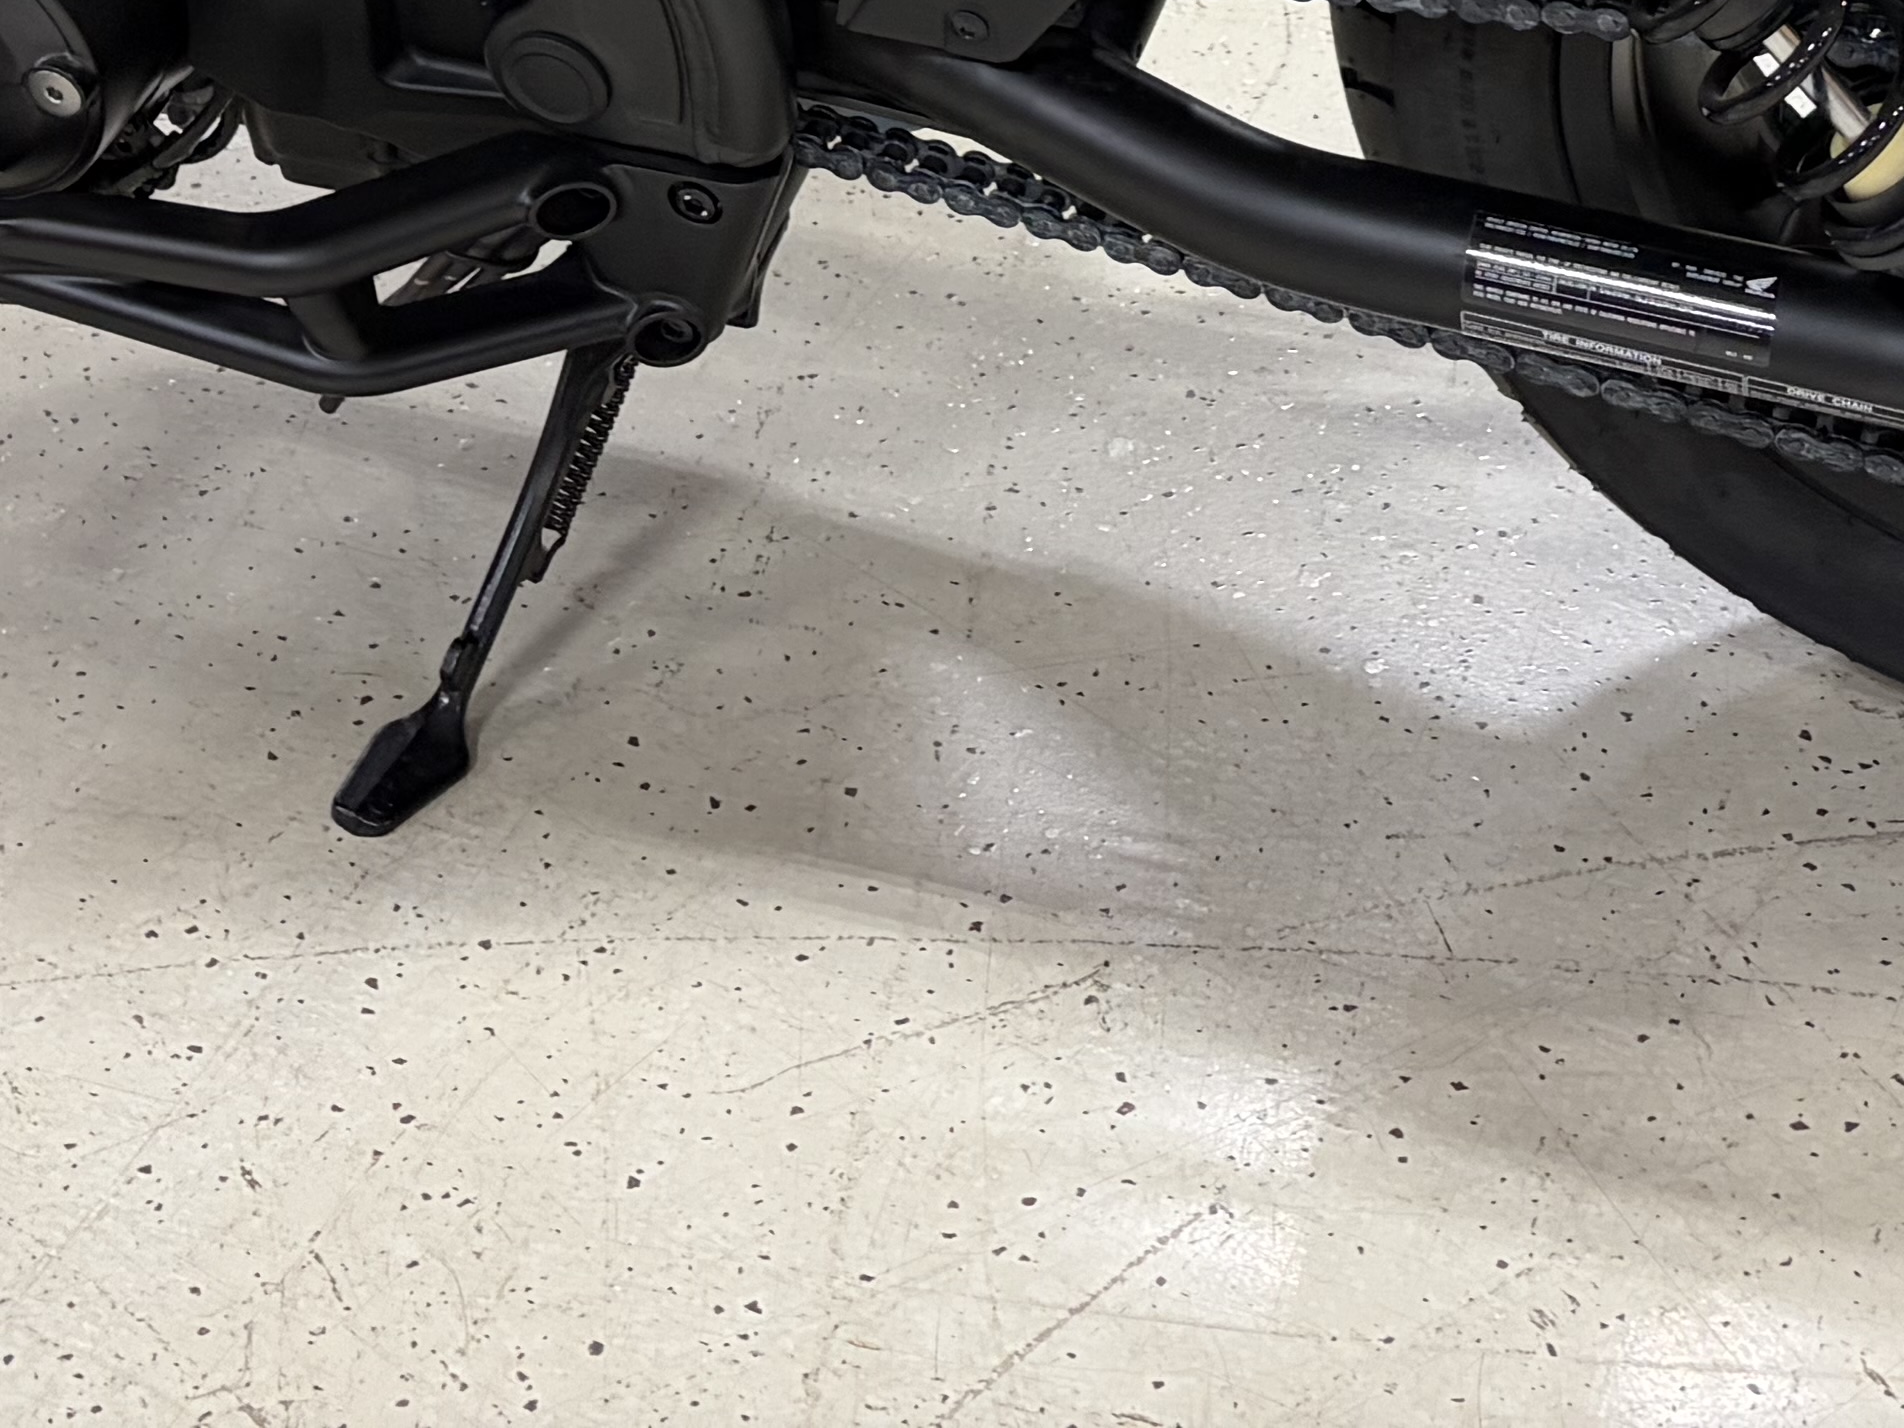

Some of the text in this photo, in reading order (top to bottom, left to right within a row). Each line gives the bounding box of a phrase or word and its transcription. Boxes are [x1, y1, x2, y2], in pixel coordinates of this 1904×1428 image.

[1542, 330, 1569, 344] TIRE
[1575, 338, 1662, 368] INFORMATION
[1786, 386, 1825, 404] DRIVE
[1831, 396, 1873, 414] CHAIN
